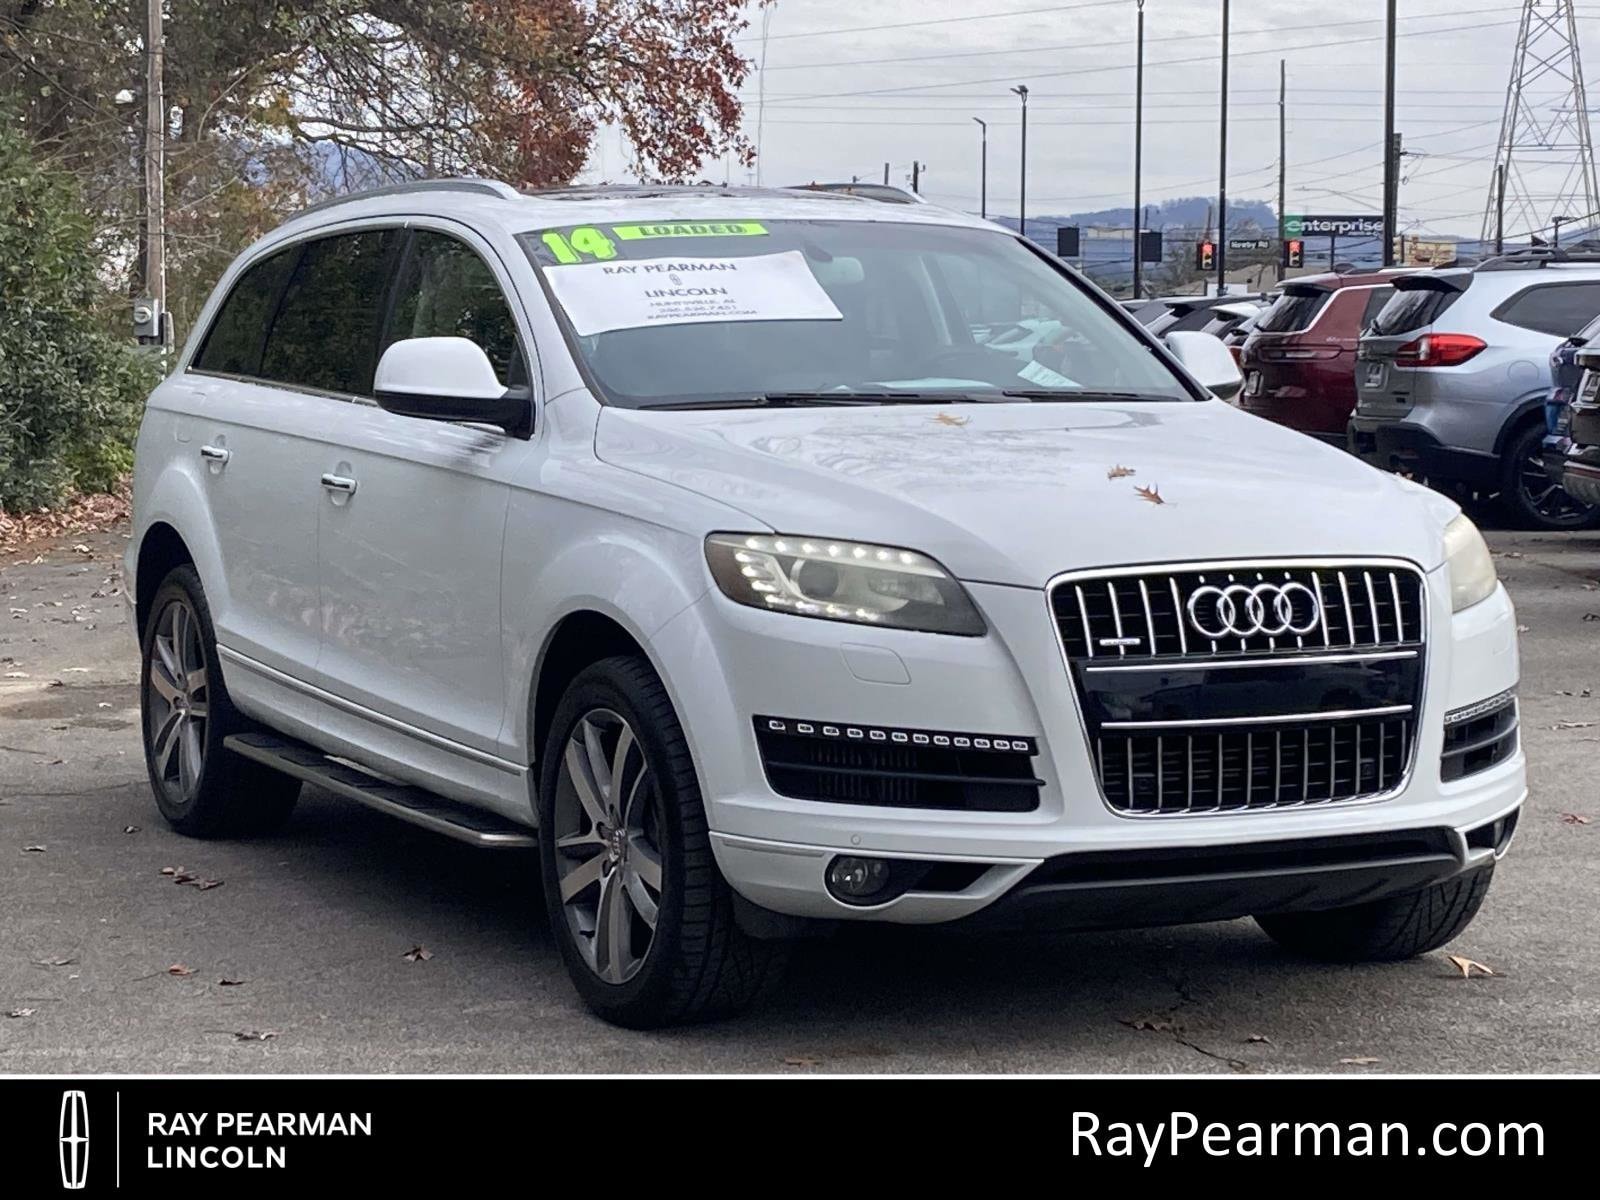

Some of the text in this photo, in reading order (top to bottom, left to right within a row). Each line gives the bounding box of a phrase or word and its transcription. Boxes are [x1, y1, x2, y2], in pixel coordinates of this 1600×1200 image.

[638, 224, 747, 236] LOADED
[1284, 218, 1383, 234] enterprise
[541, 226, 618, 264] 14
[602, 263, 737, 275] RAY PEARMAN
[644, 287, 728, 298] LINCOLN
